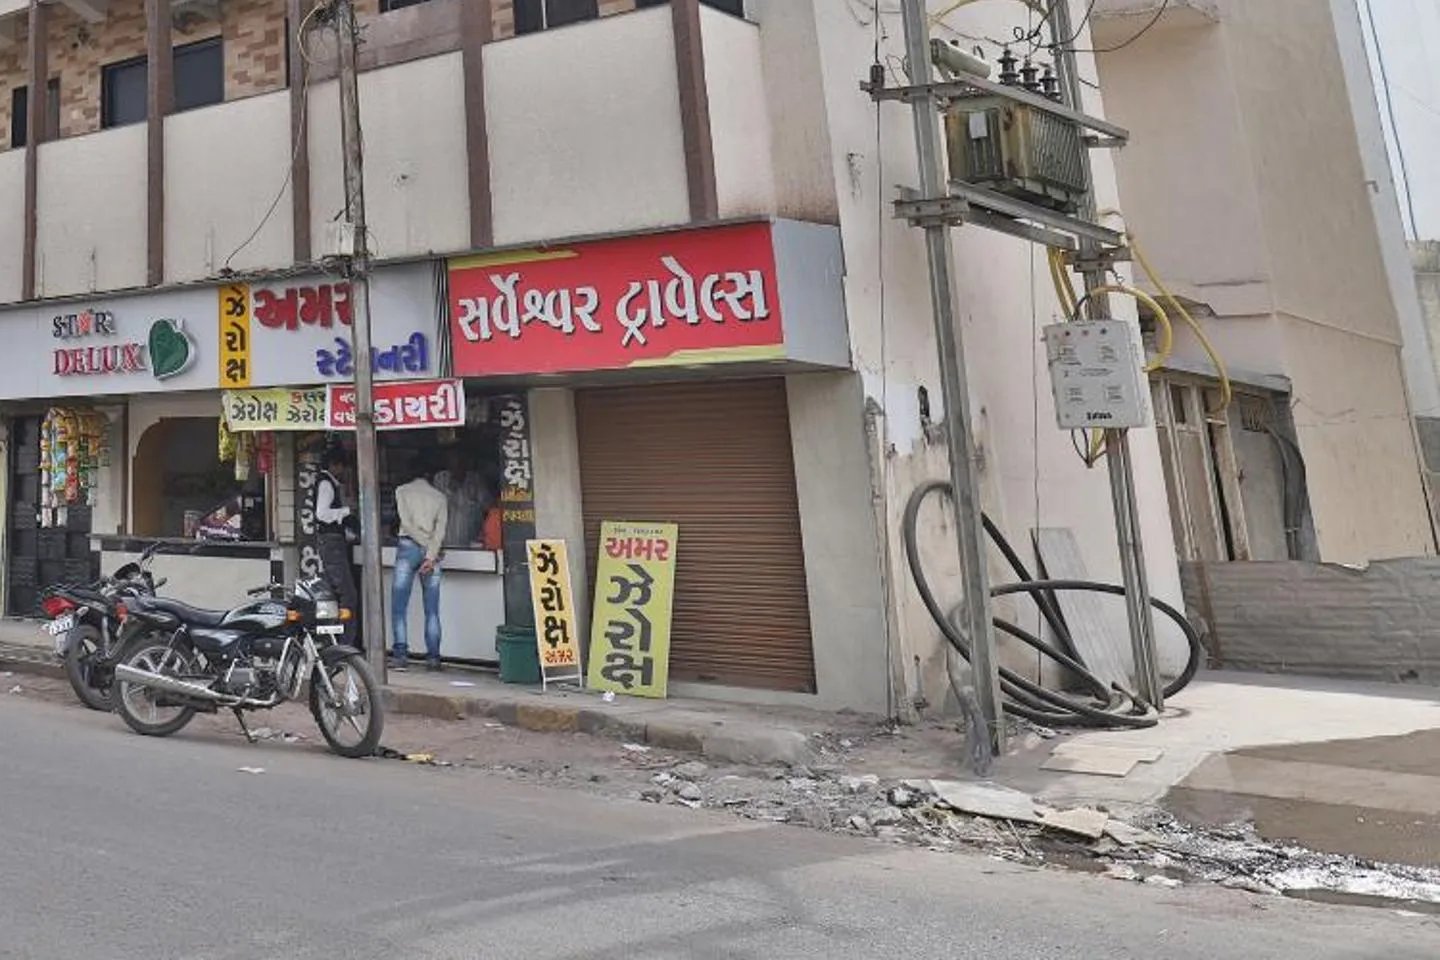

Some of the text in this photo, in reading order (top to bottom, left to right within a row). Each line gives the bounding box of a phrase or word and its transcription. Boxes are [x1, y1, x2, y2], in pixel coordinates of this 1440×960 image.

[253, 282, 353, 331] અમર
[458, 256, 769, 346] સર્વેશ્વર ટ્રાવેલ્સ
[225, 286, 247, 383] ઝેરોક્ષ
[316, 331, 428, 376] સ્ટેનરી
[53, 343, 145, 377] DELUX
[231, 393, 278, 423] ઝેરોક્ષ
[374, 384, 458, 425] ડાયરી
[604, 536, 670, 562] અમર
[536, 543, 570, 649] ઝેરોક્ષ
[600, 563, 655, 690] ઝેરોક્ષ
